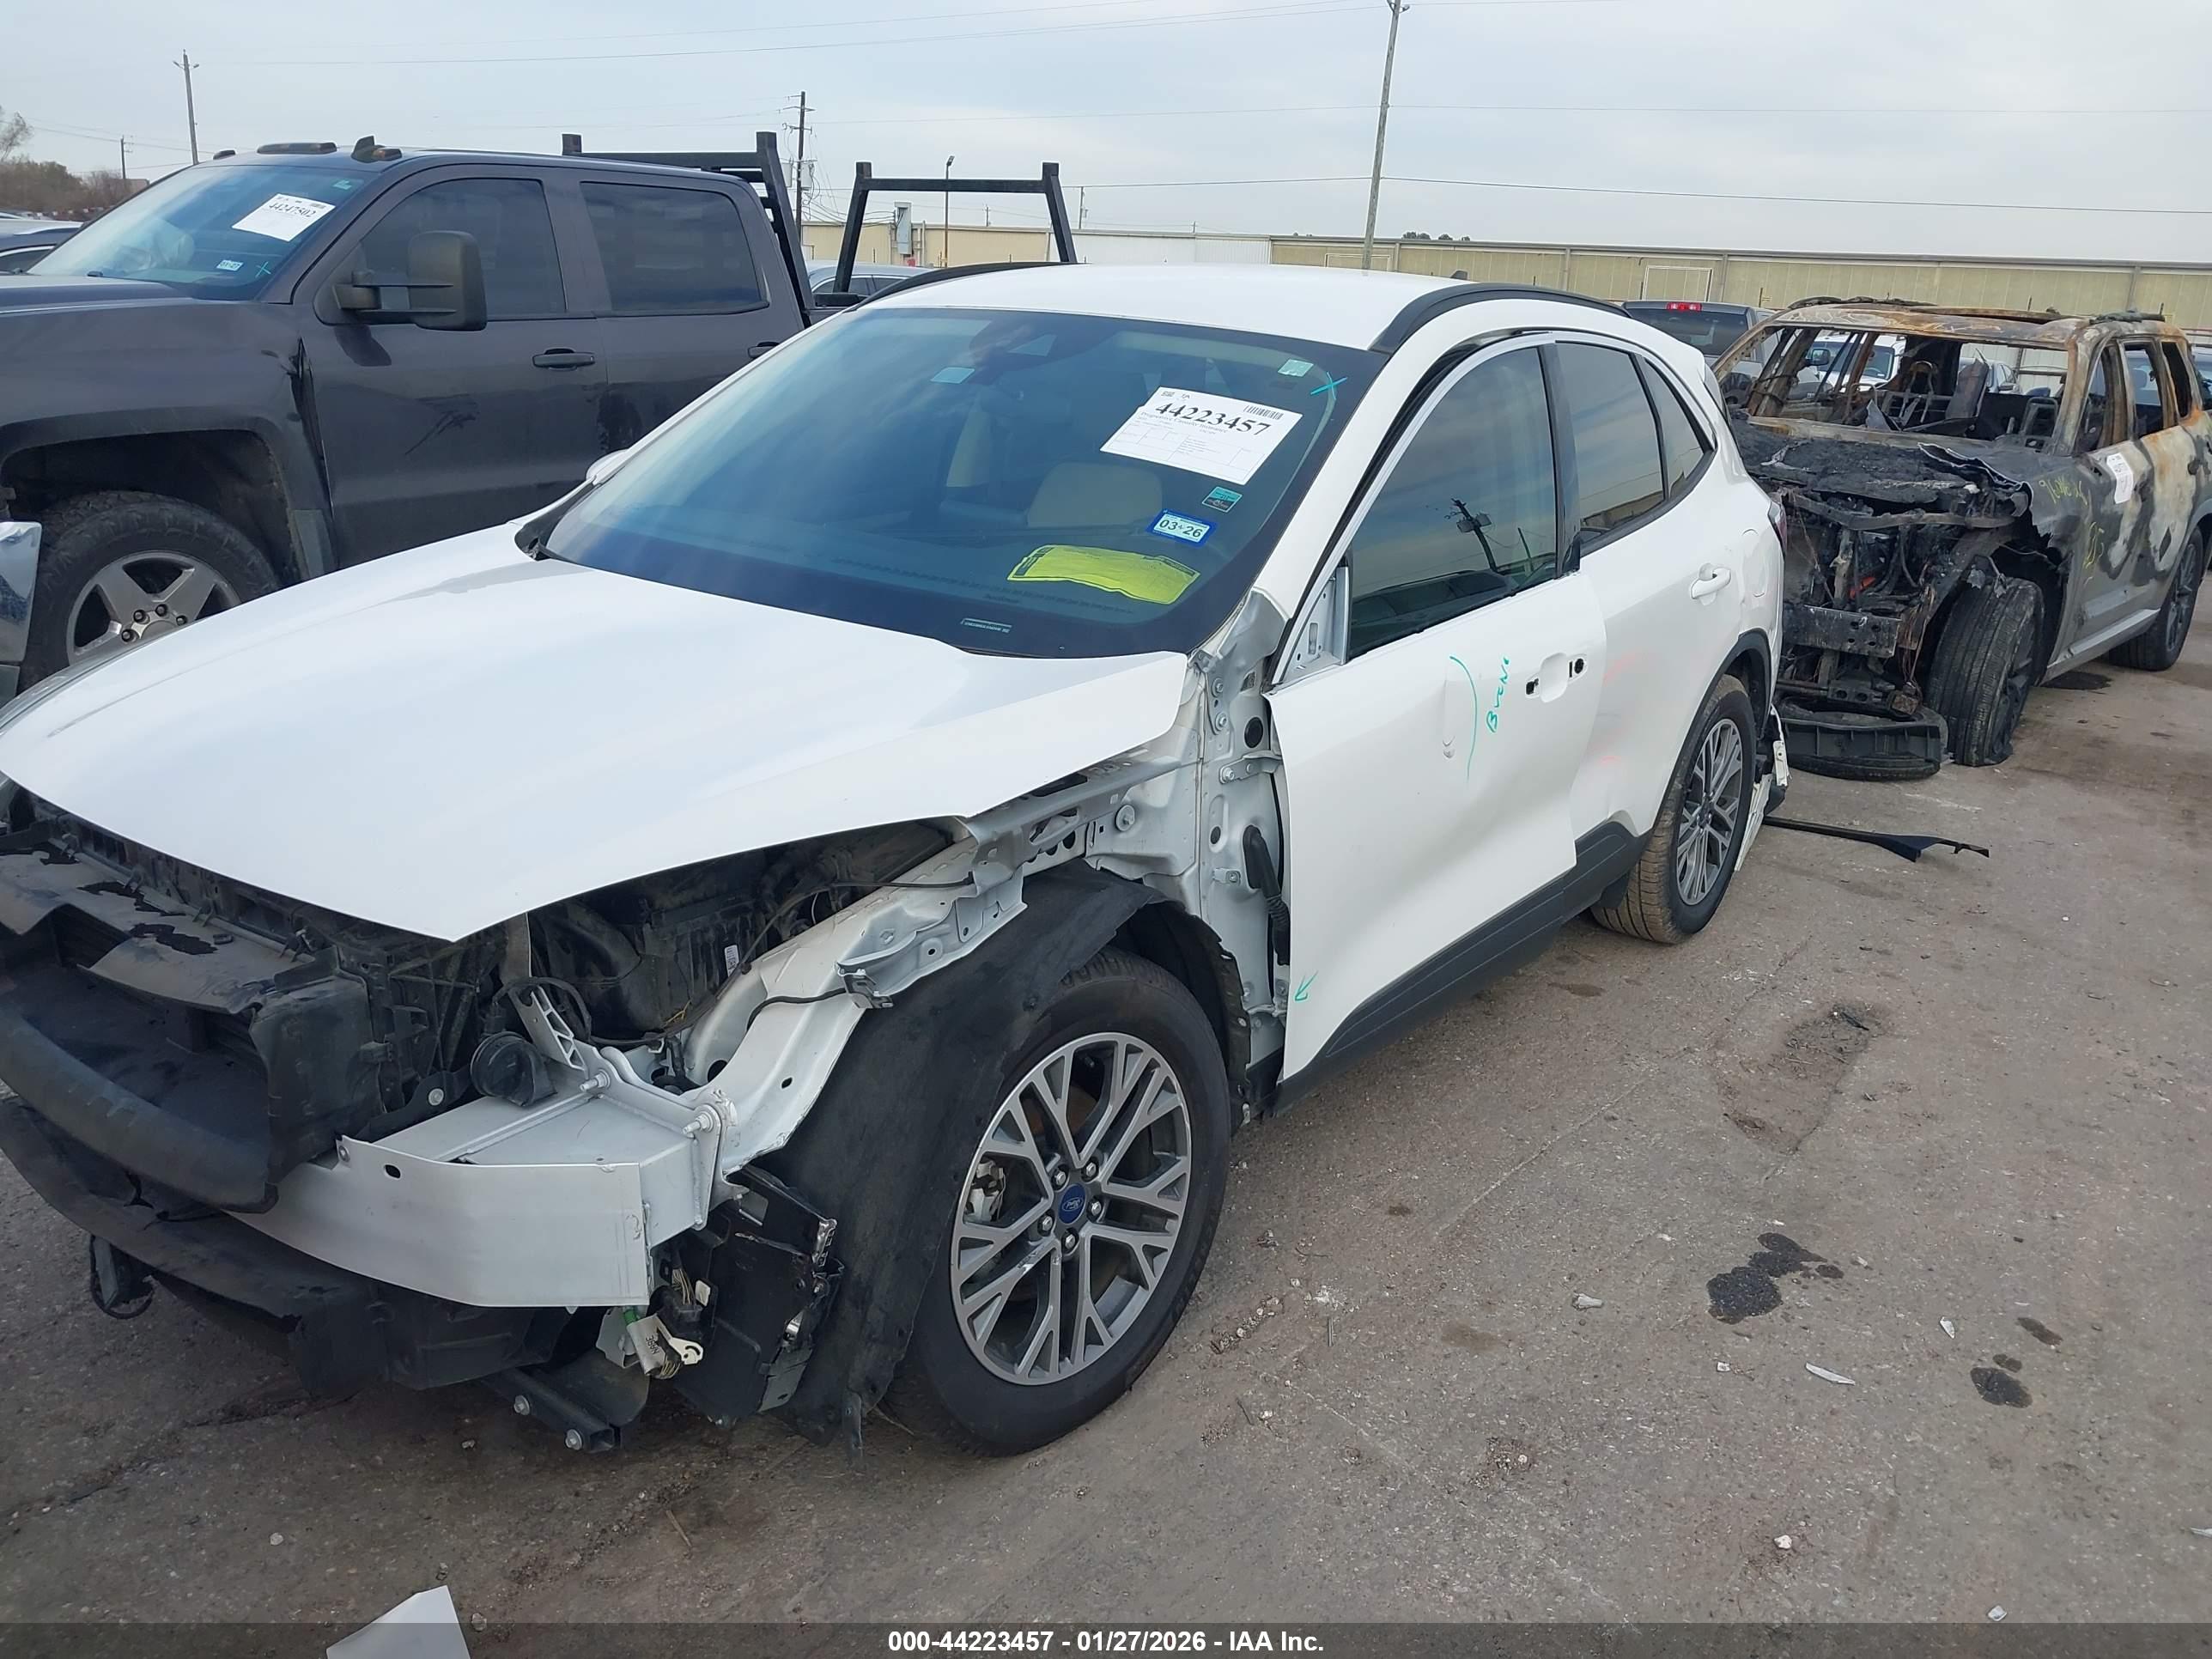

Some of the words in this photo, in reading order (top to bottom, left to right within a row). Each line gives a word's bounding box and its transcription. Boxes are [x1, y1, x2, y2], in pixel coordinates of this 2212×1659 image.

[1155, 402, 1272, 436] 44223457
[1159, 519, 1178, 531] 03
[1182, 526, 1203, 538] 26
